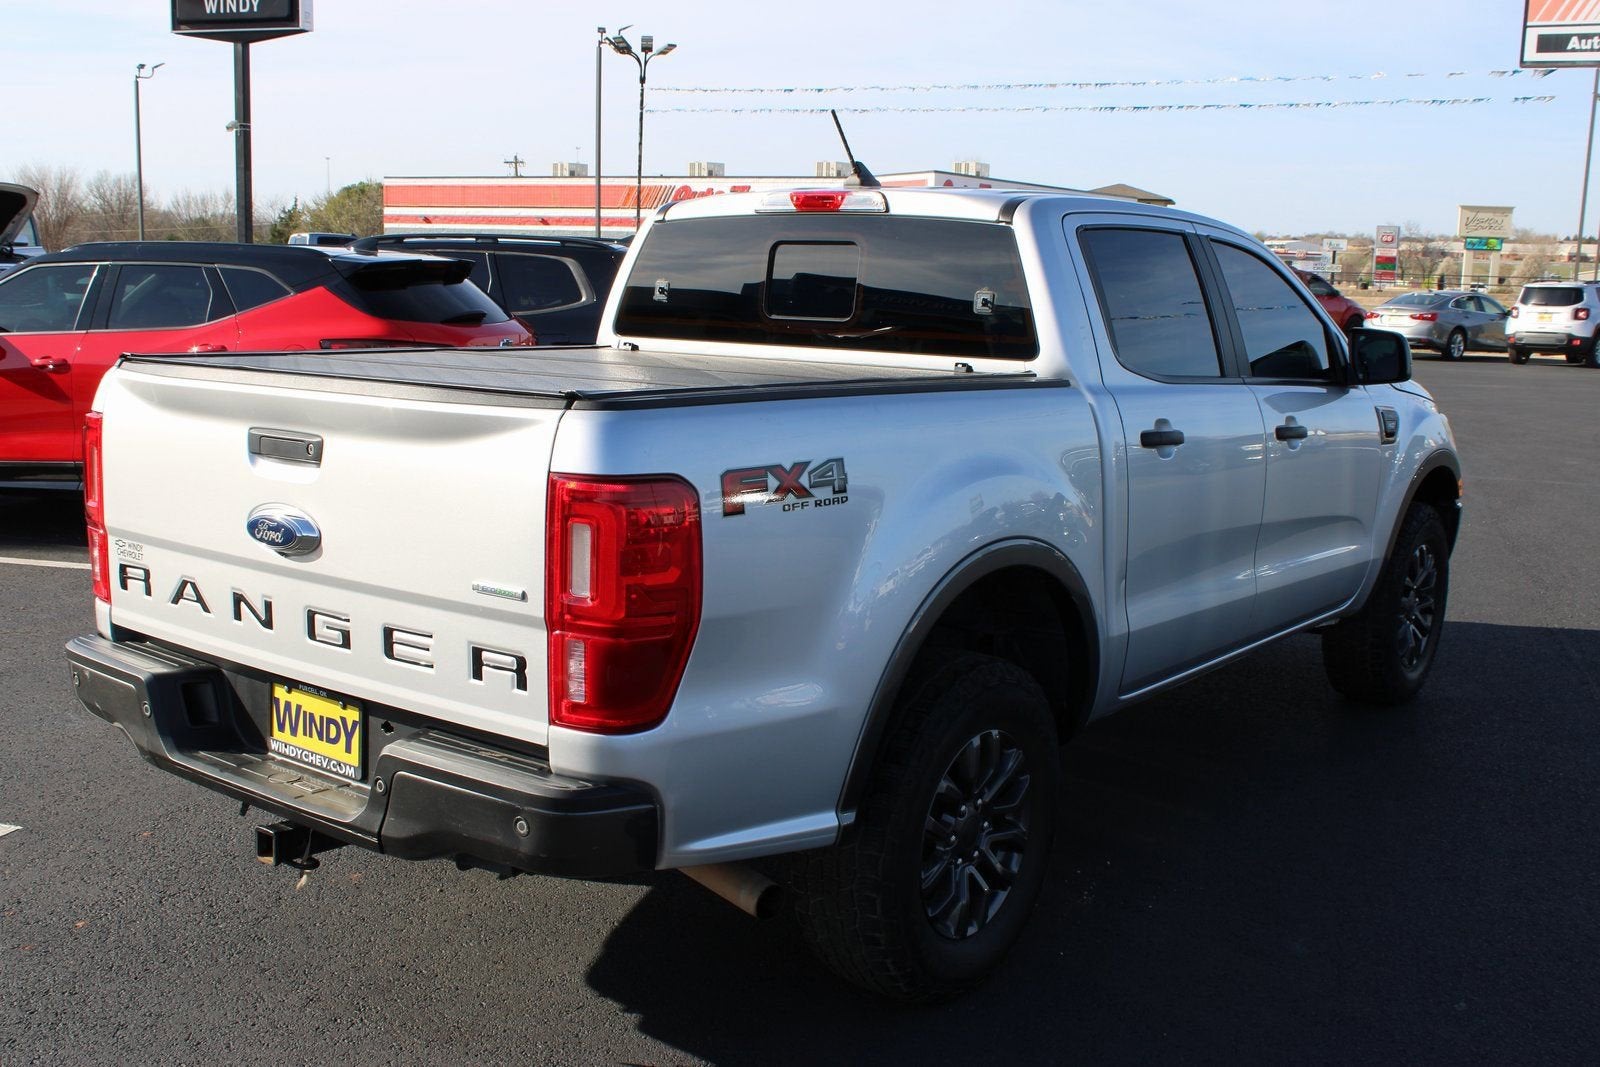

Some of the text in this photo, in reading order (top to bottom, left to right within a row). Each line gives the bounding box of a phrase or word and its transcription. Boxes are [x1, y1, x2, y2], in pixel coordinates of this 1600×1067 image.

[204, 0, 260, 14] WINDY
[720, 457, 848, 517] FX4
[782, 495, 849, 513] OFF ROAD
[254, 519, 285, 543] Ford
[118, 561, 528, 692] RANGER
[273, 696, 360, 754] WINDY
[270, 738, 356, 778] WINDYCHEV.COM
